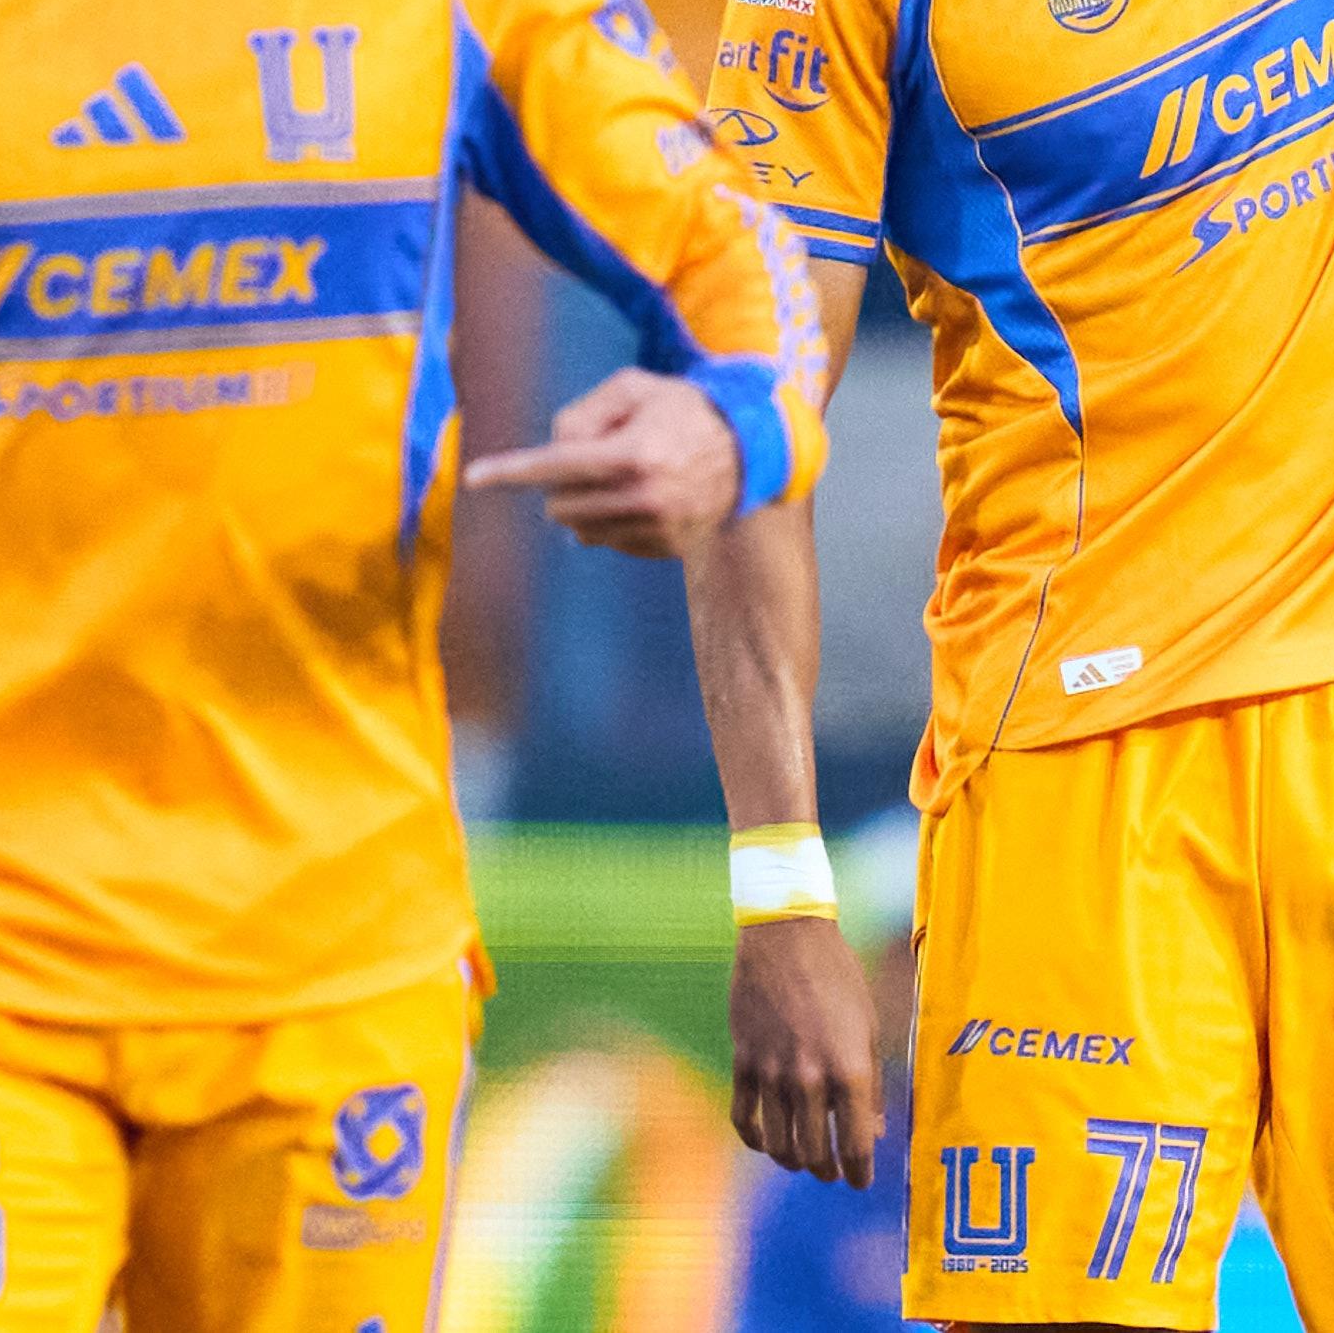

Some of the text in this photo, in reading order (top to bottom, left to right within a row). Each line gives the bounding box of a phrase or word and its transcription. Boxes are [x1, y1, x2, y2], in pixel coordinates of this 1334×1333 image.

[718, 41, 759, 72] art
[26, 237, 327, 320] CEMEX
[989, 1026, 1136, 1066] CEMEX
[940, 1146, 1035, 1256] U
[1086, 1117, 1209, 1284] 77
[991, 1258, 1029, 1273] 2025
